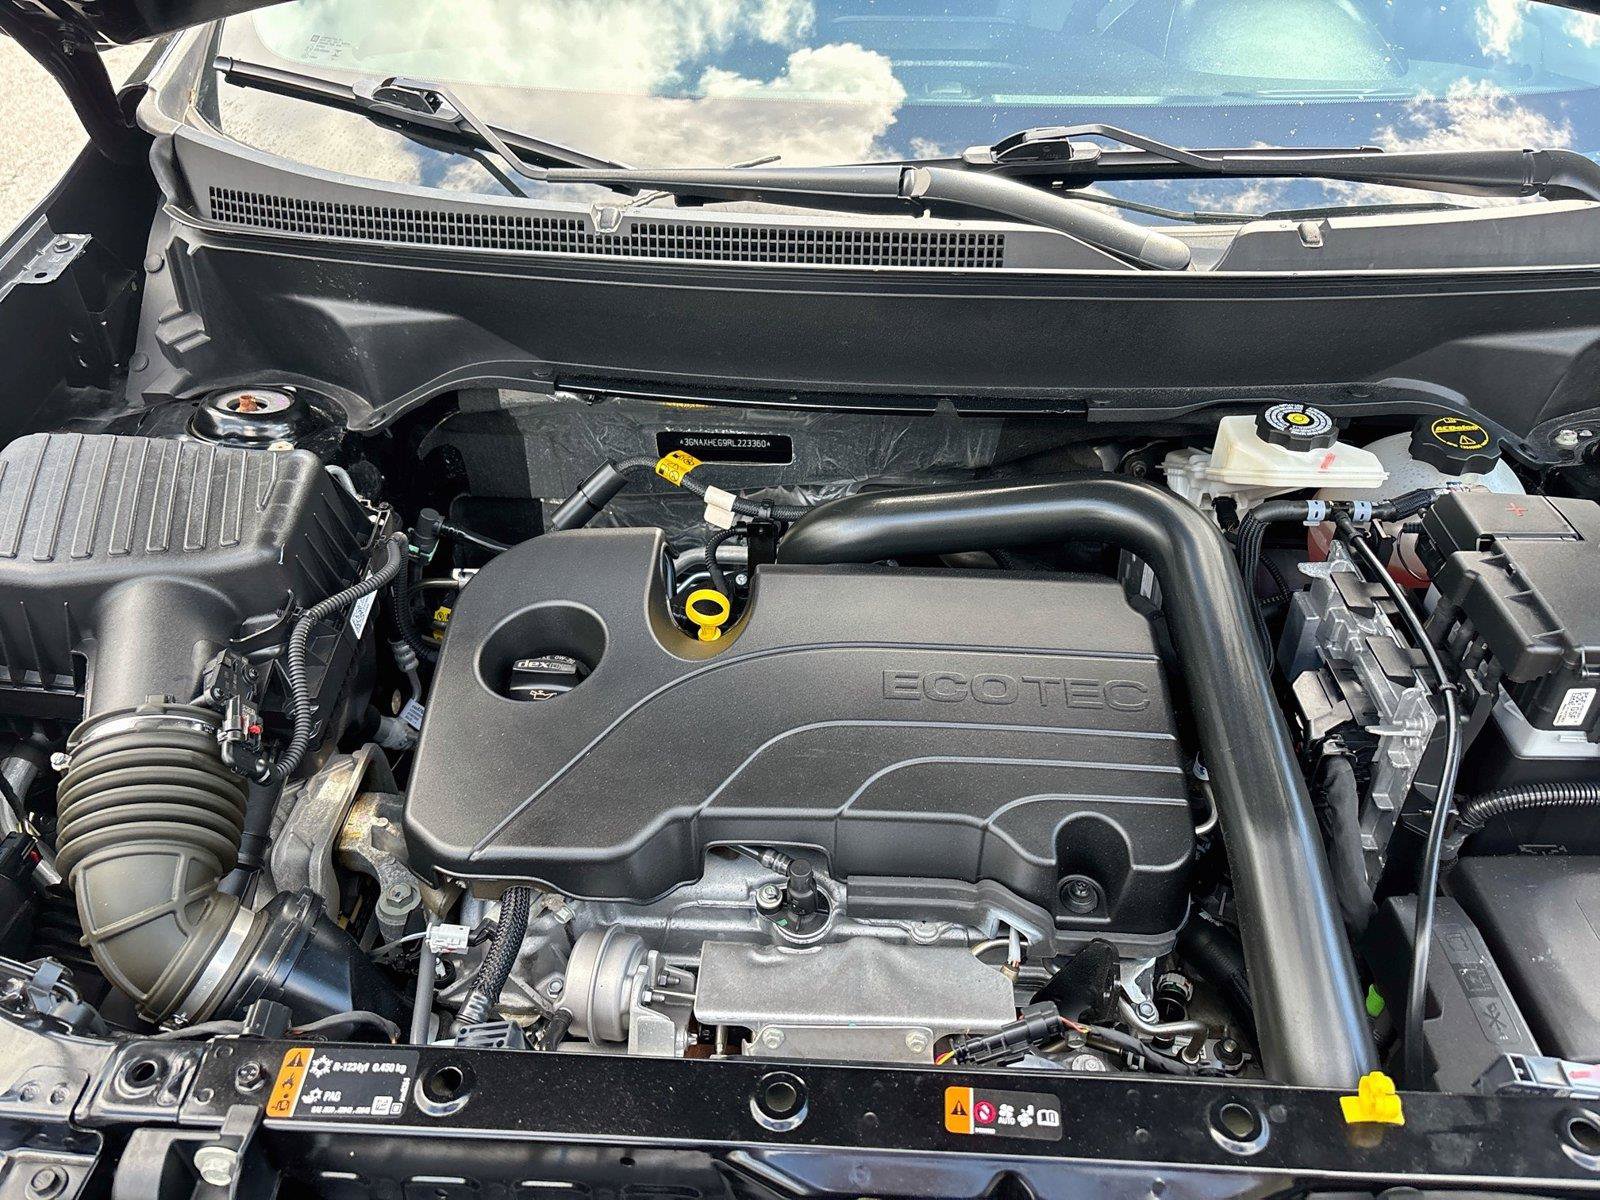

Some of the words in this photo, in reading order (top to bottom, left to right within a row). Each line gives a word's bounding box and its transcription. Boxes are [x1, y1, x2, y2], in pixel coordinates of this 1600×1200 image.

[882, 670, 1151, 712] ECOTEC
[395, 1063, 407, 1075] kg
[323, 1091, 342, 1102] PAG
[997, 1116, 1016, 1125] AUTO
